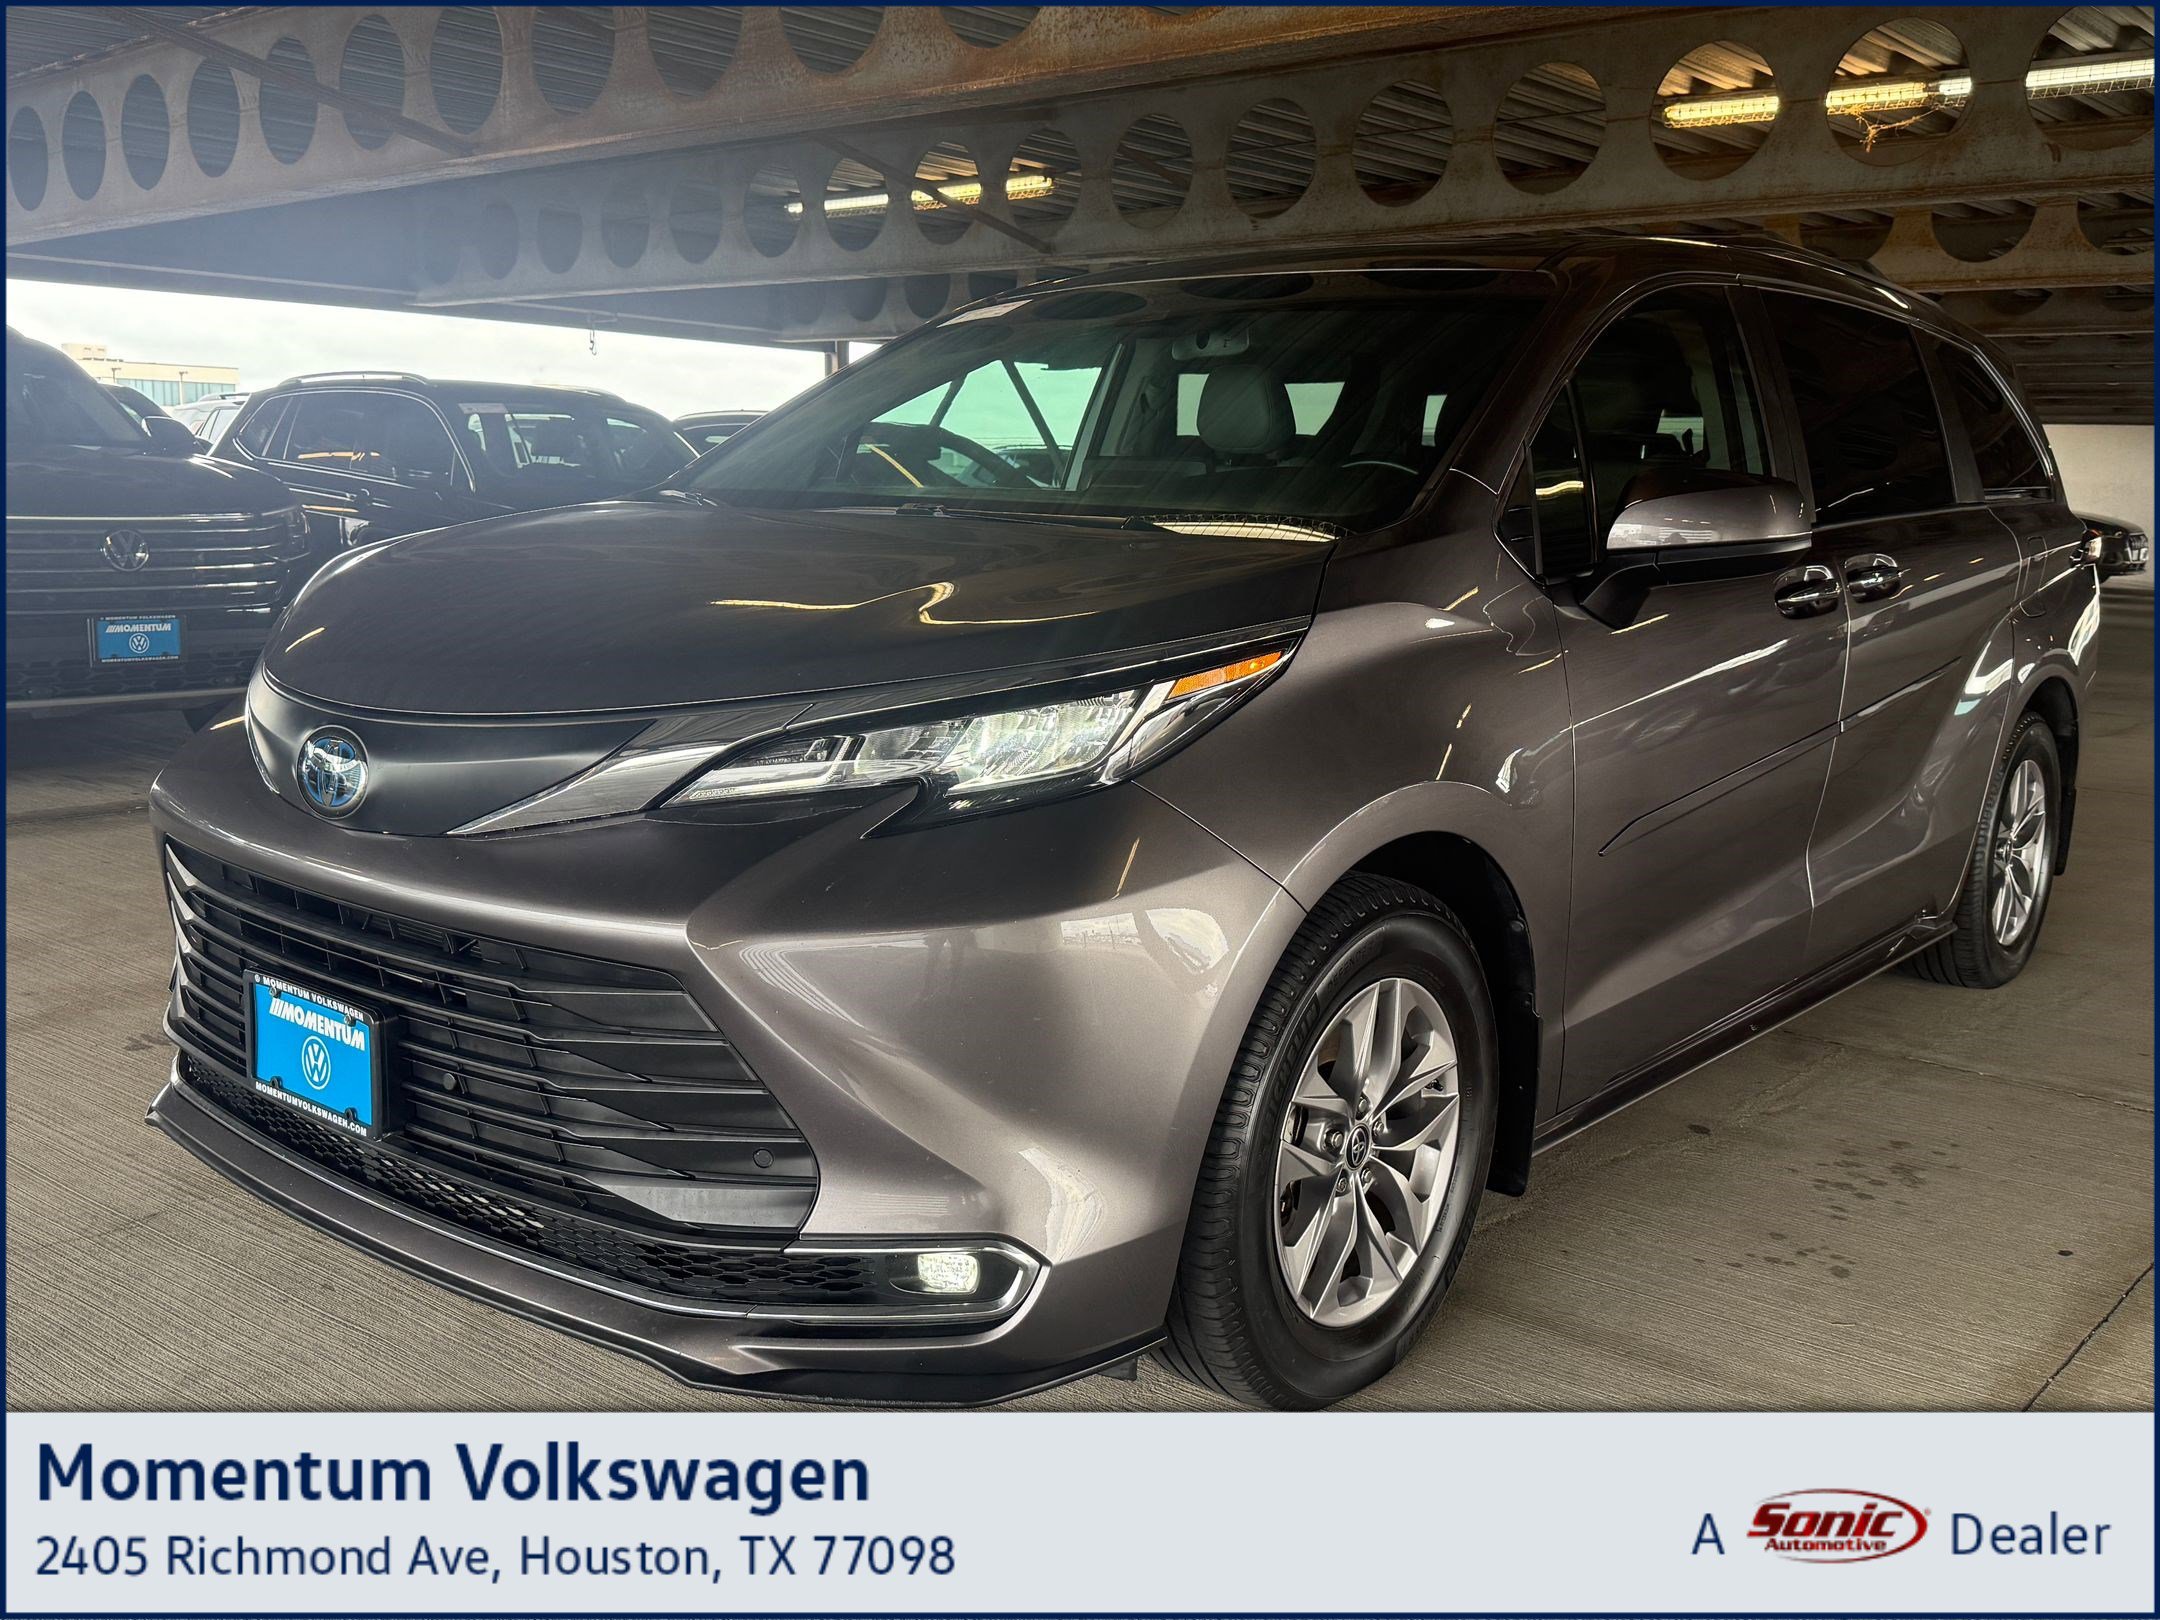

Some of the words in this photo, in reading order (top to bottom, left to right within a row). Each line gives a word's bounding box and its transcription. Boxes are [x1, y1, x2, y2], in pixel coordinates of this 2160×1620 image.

[263, 976, 311, 1000] MOMENTUM
[311, 992, 364, 1021] VOLKSWAGEN
[273, 998, 366, 1052] MOMENTUM
[255, 1081, 367, 1138] MOMENTUMVOLKSWAGEN.COM
